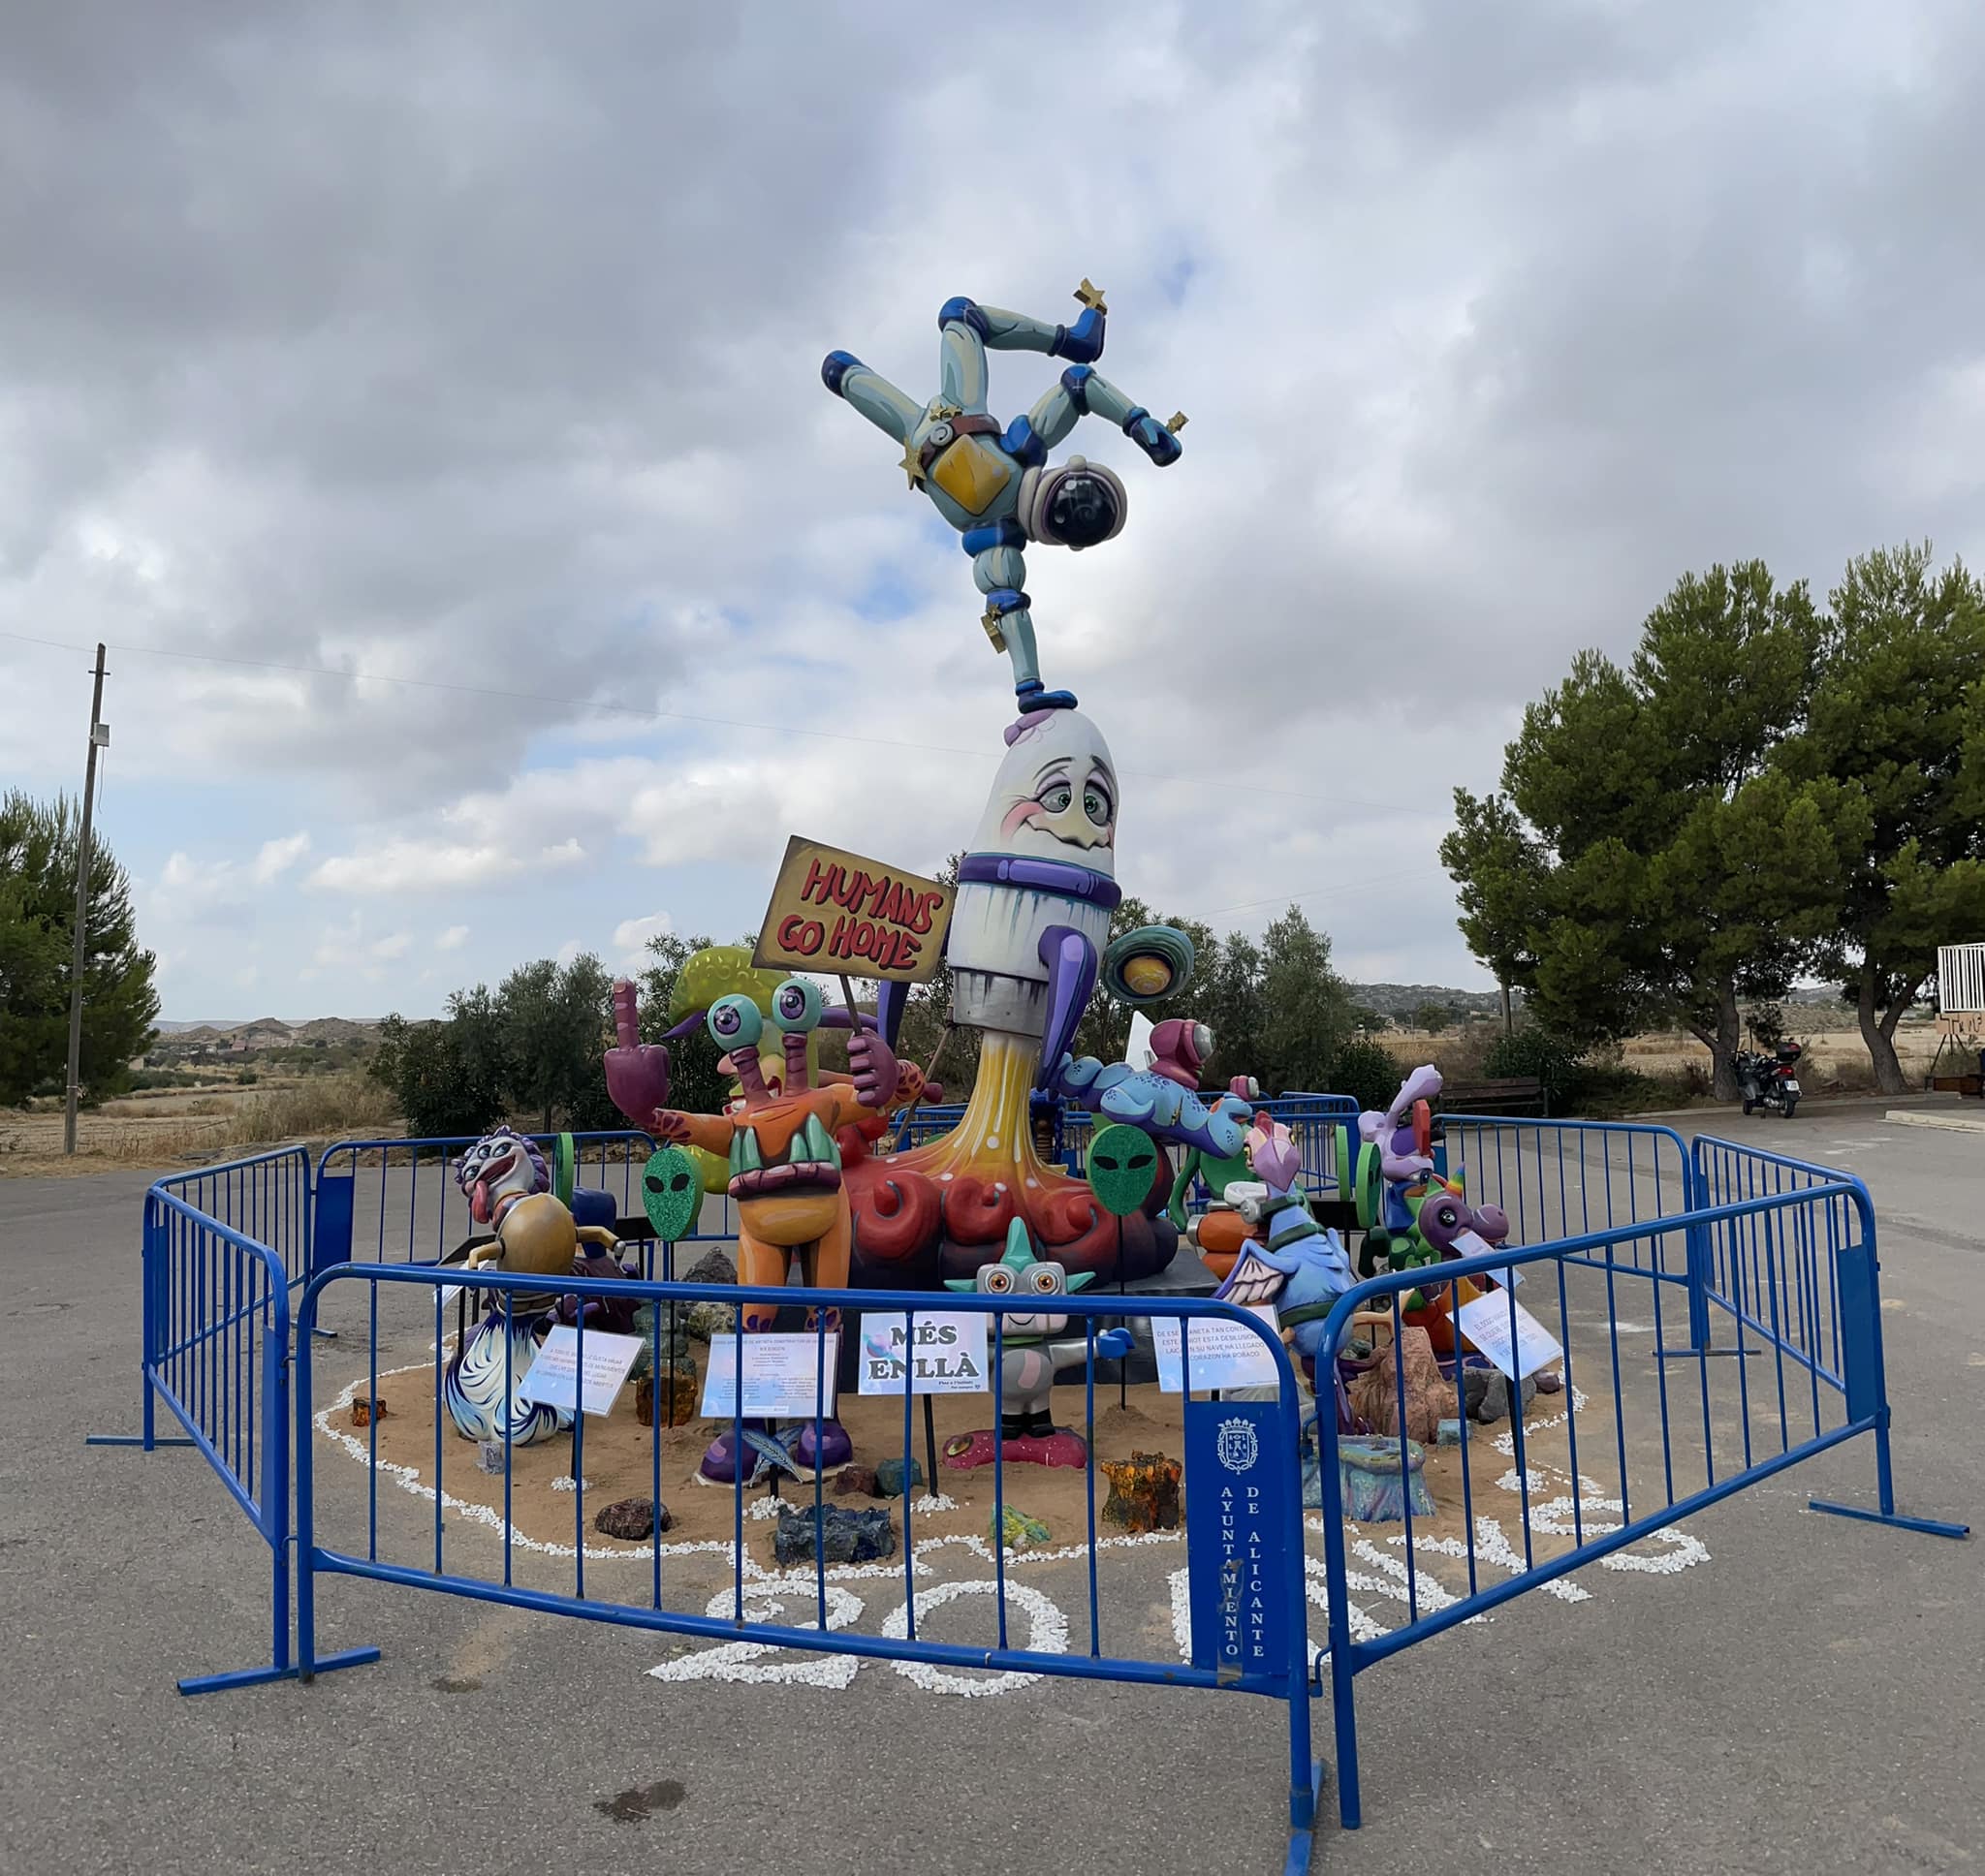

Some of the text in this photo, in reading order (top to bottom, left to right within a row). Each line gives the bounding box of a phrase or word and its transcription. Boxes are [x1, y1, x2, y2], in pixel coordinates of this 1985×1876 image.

[802, 858, 943, 934] HUMANS
[777, 914, 922, 970] GO HOME
[868, 1353, 979, 1379] ENLLÀ
[891, 1321, 958, 1345] MÉS
[1220, 1486, 1239, 1656] AYUNTAMIENTO
[1246, 1486, 1264, 1657] DE ALICANTE
